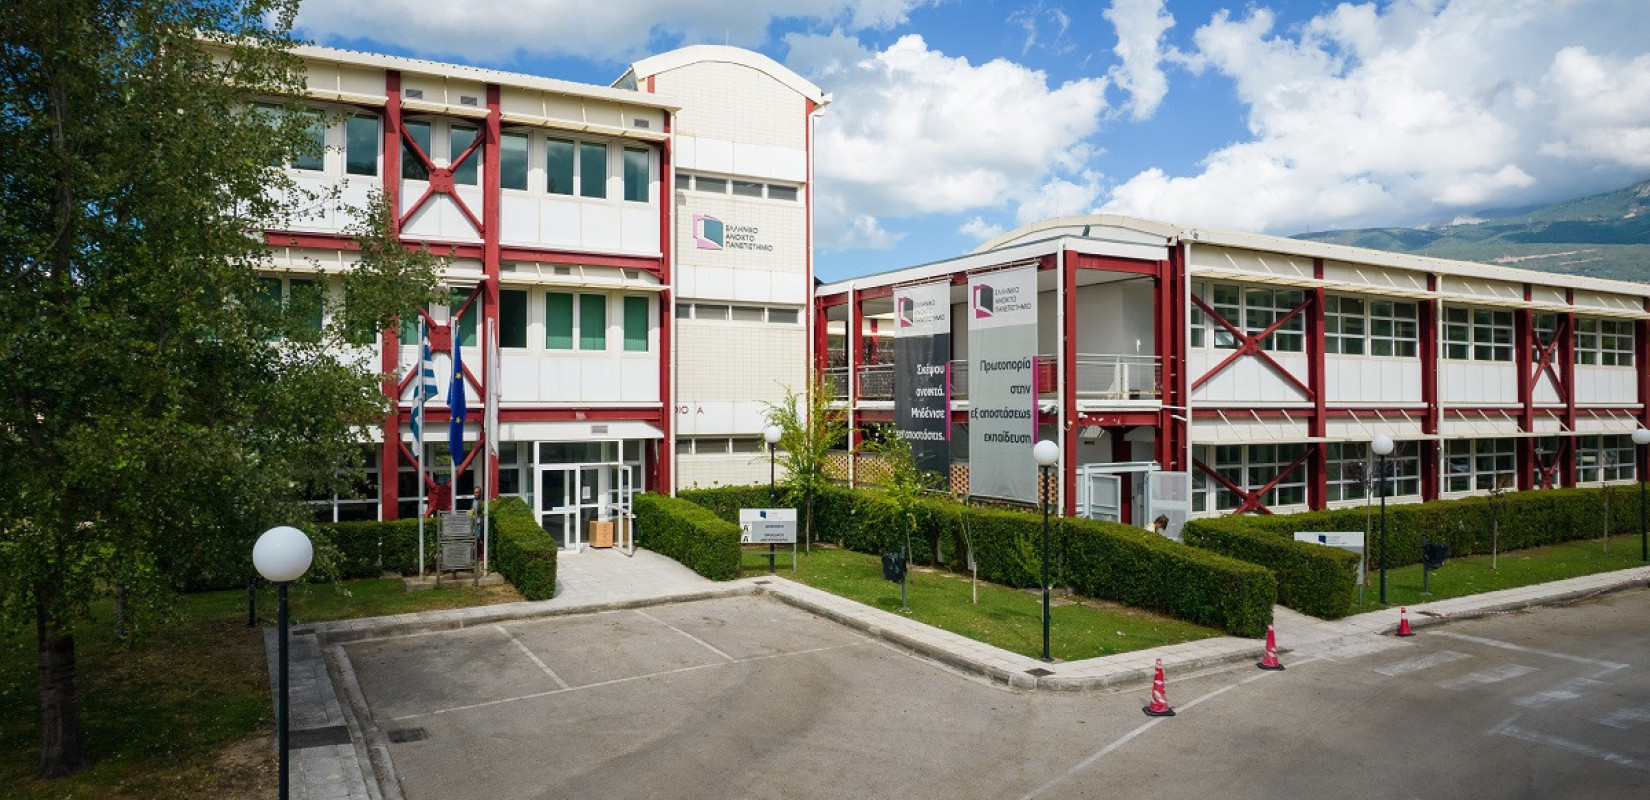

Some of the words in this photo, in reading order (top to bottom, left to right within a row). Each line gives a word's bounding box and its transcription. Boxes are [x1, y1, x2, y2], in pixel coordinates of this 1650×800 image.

[725, 233, 755, 242] ΑΝΟΙΚΤΟ
[916, 363, 945, 377] Σκέψου
[979, 357, 1031, 374] Πρωτοπορία
[915, 385, 945, 397] ανοικτά.
[1010, 385, 1031, 394] στην
[911, 407, 945, 419] Μηδένισε
[970, 407, 980, 421] εξ
[980, 406, 1031, 419] αποστάσεως
[983, 430, 1031, 444] εκπαίδευση
